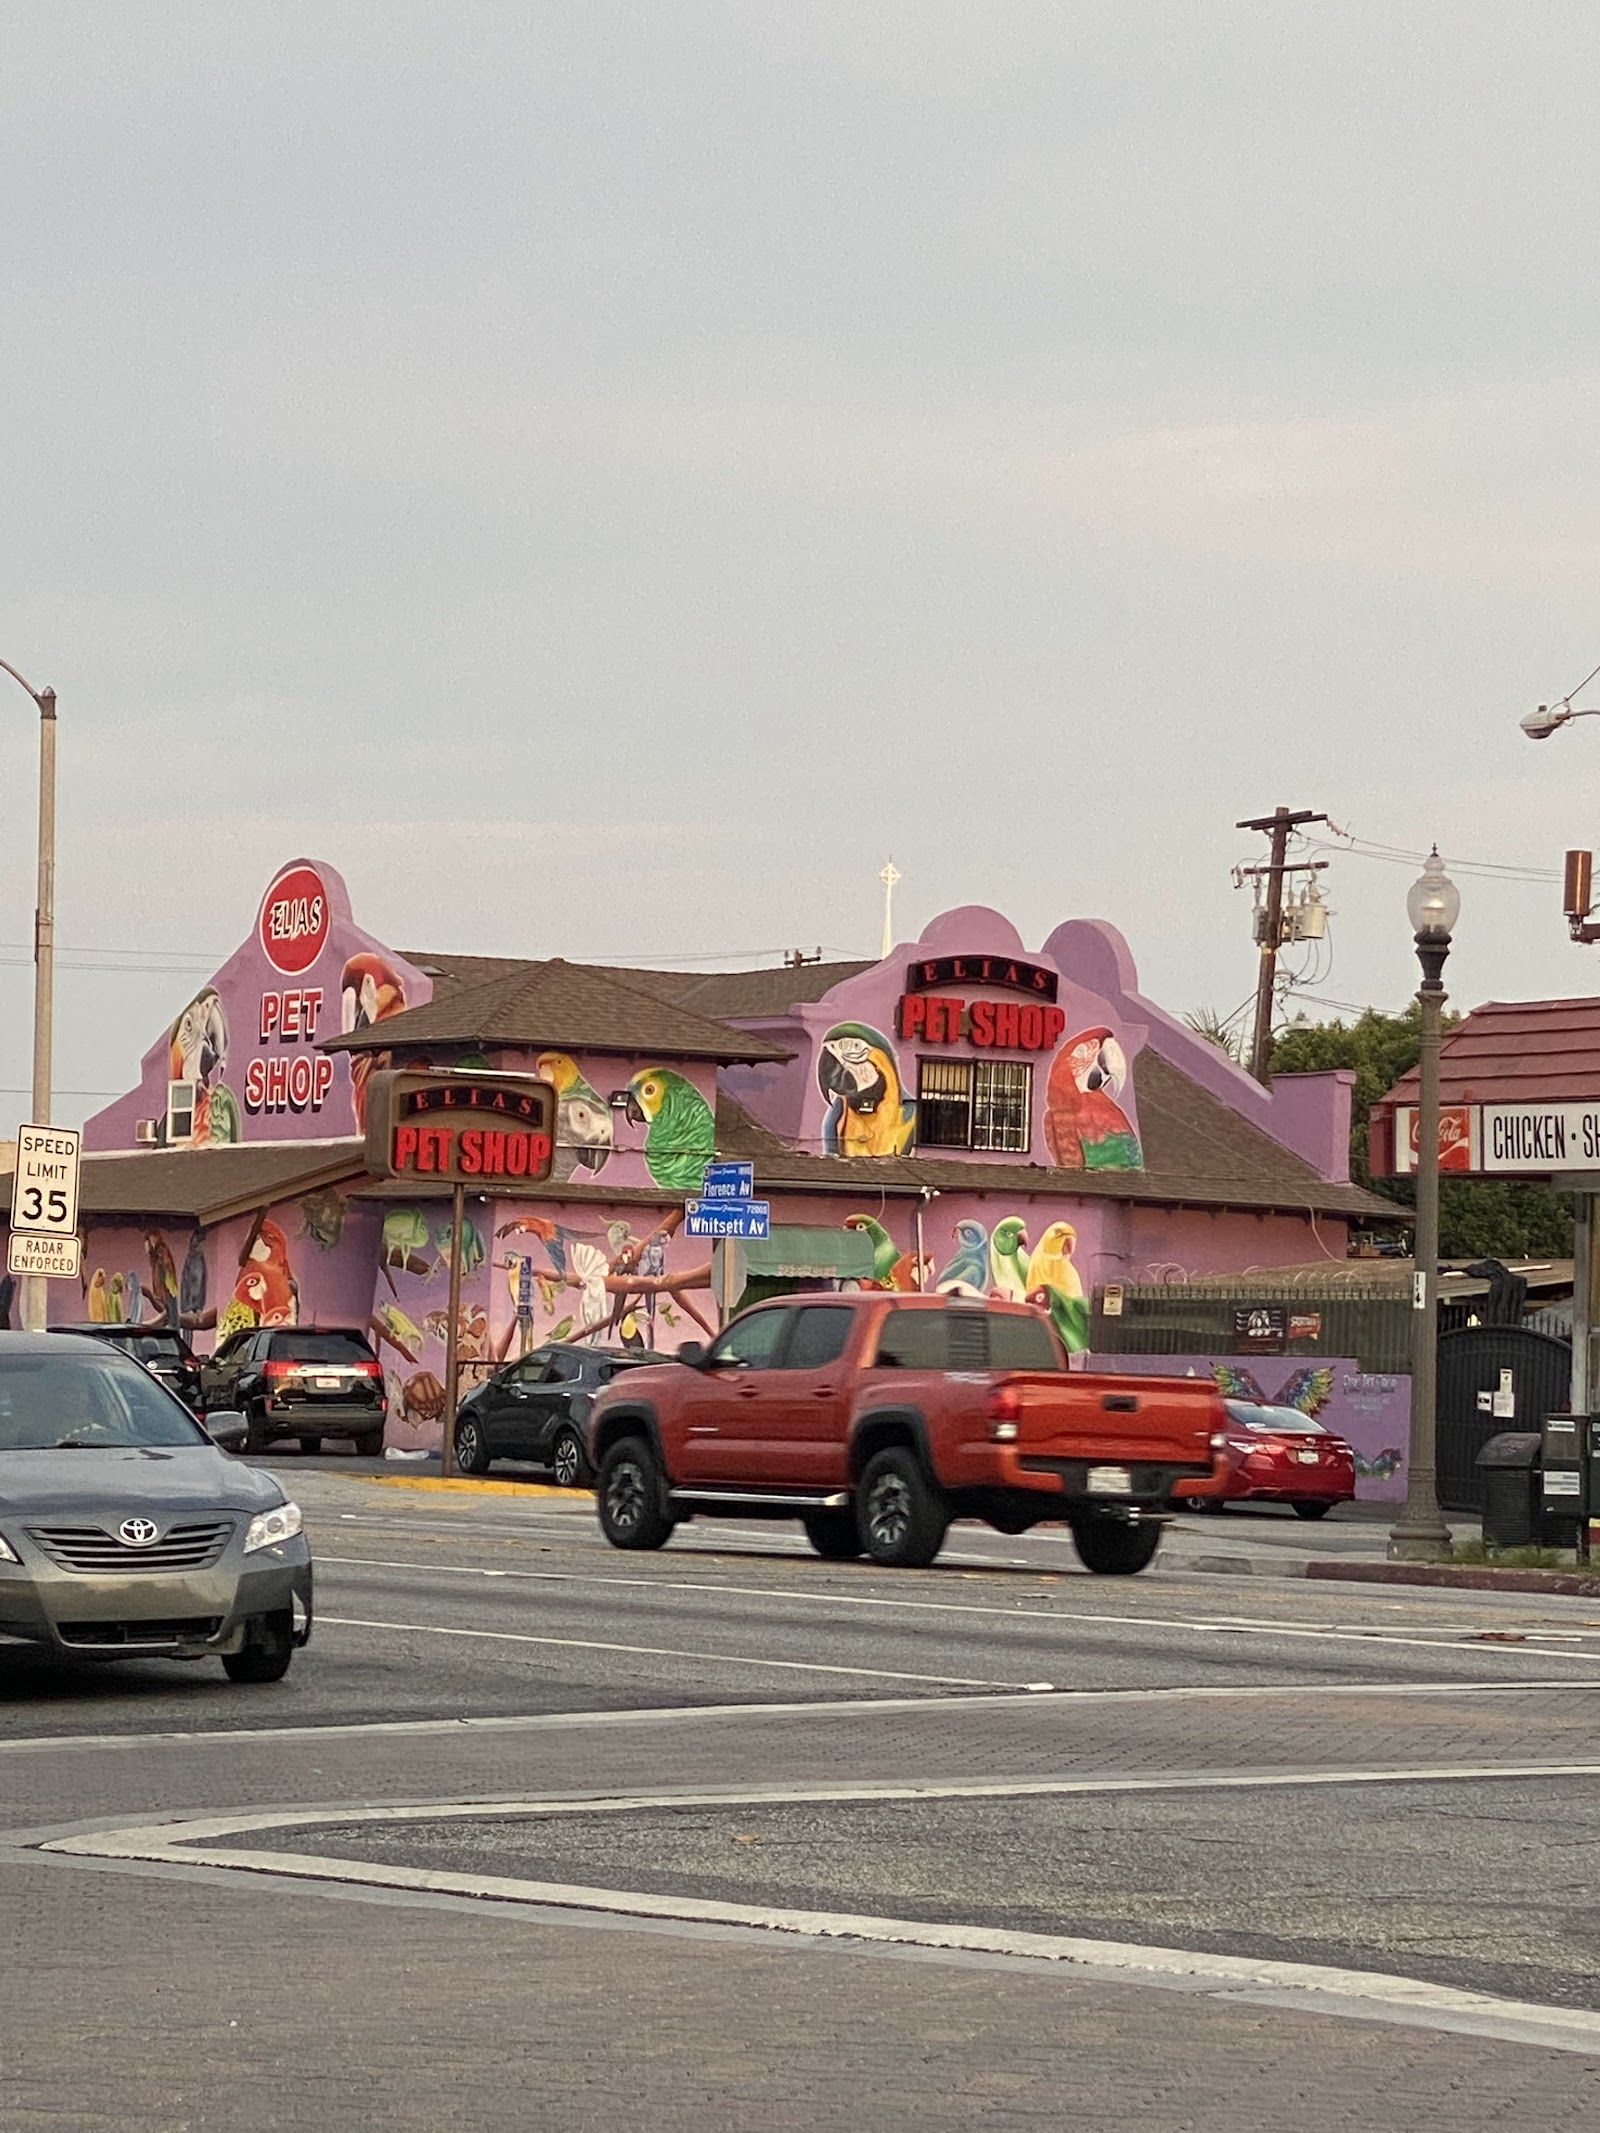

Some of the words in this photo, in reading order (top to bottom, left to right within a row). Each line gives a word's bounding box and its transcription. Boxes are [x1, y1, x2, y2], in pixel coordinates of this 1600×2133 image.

[269, 896, 323, 941] ELIAS
[923, 959, 1047, 989] ELIAS
[260, 988, 324, 1040] PET
[901, 994, 965, 1043] PET
[971, 1000, 1066, 1050] SHOP
[246, 1055, 334, 1110] SHOP
[415, 1087, 533, 1114] ELIAS
[23, 1136, 74, 1156] SPEED
[395, 1126, 456, 1172] PET
[460, 1129, 551, 1176] SHOP
[1493, 1115, 1566, 1159] CHICKEN
[27, 1161, 67, 1180] LIMIT
[739, 1180, 750, 1196] Av
[22, 1187, 67, 1223] 35
[690, 1217, 744, 1235] Whitsett
[748, 1218, 765, 1235] Av
[26, 1240, 64, 1255] RADAR
[13, 1255, 74, 1272] ENFORCED
